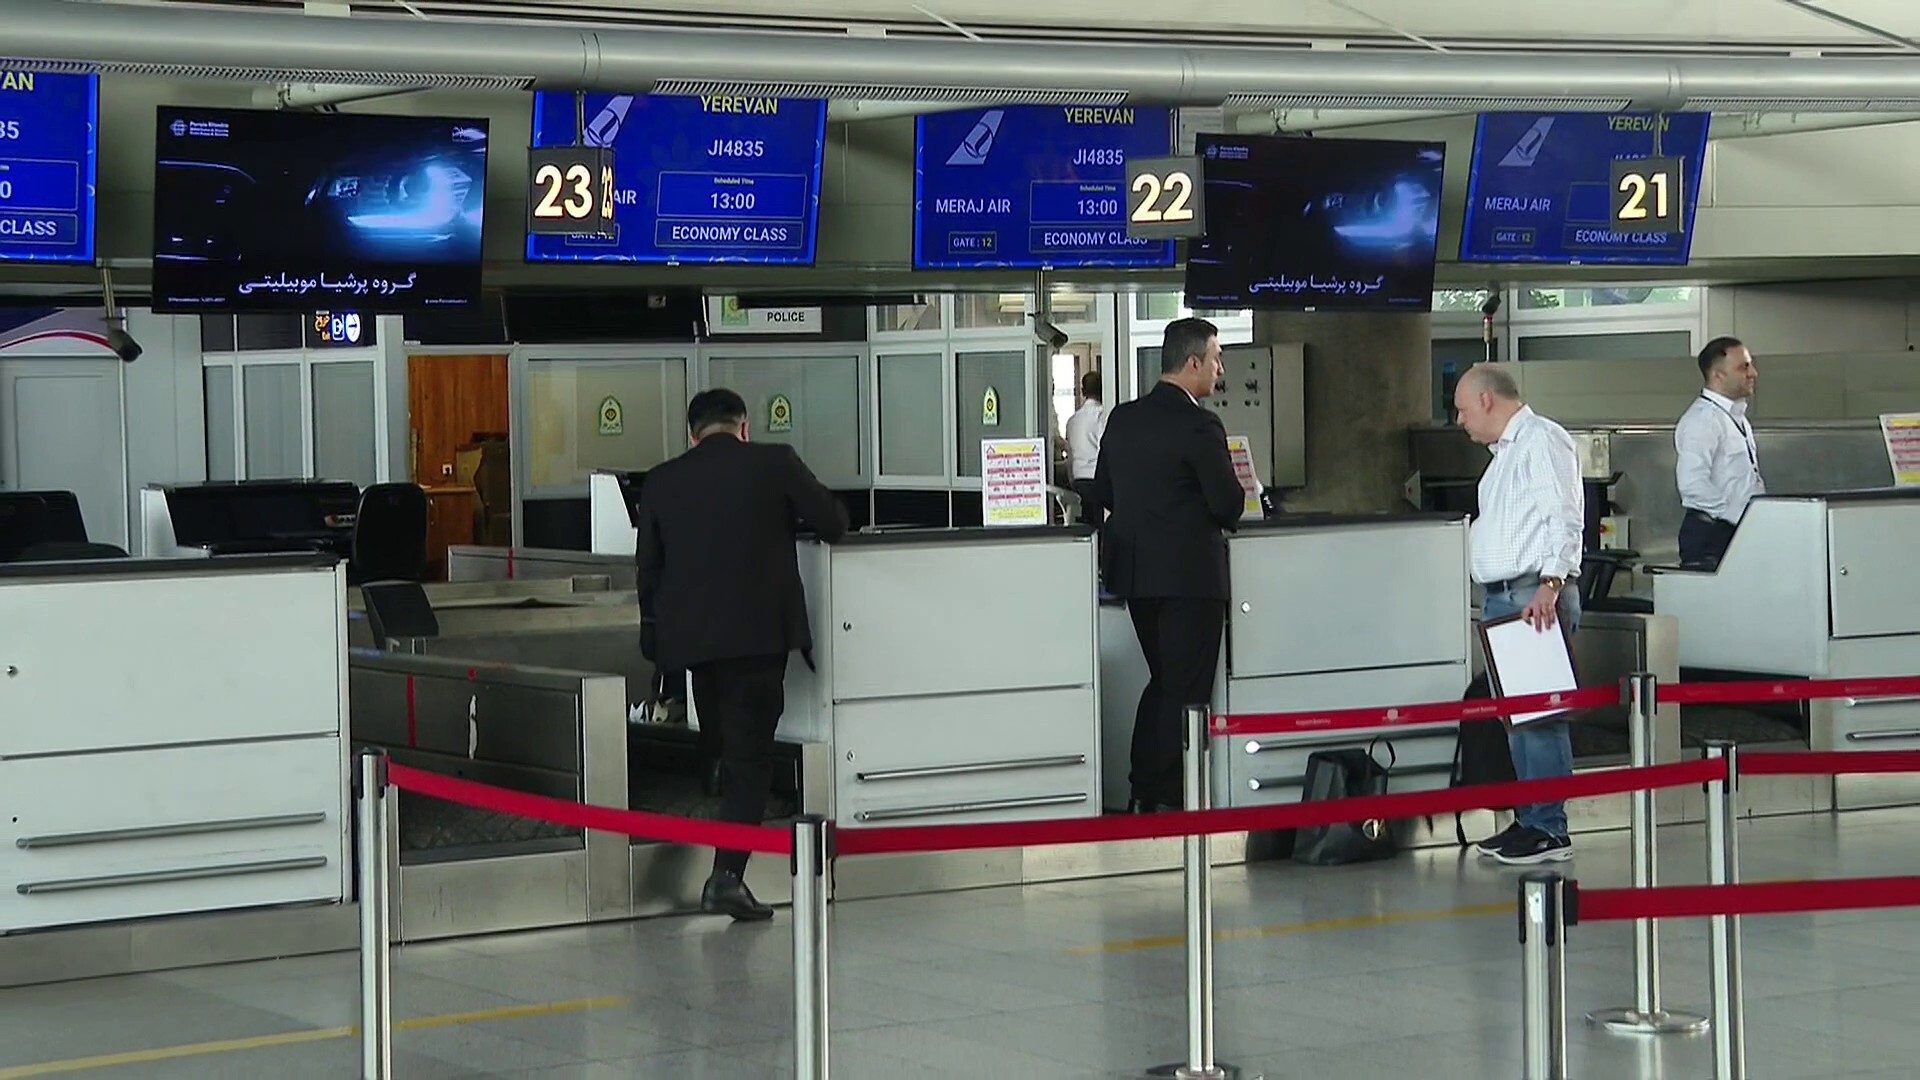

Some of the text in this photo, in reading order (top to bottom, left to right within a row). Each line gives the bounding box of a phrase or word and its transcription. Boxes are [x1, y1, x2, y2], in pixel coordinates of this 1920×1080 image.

[0, 71, 34, 91] AN
[701, 94, 778, 114] YEREVAN
[1065, 108, 1134, 124] YEREVAN
[707, 139, 764, 157] JI4835
[1073, 149, 1124, 166] JI4835
[533, 164, 593, 219] 23
[601, 164, 613, 219] 23
[614, 189, 637, 205] AIR
[1131, 172, 1193, 222] 22
[1618, 172, 1668, 219] 21
[710, 193, 755, 209] 13:00
[935, 199, 1011, 213] MERAJ AIR
[1077, 200, 1118, 215] 13:00
[1485, 197, 1551, 211] MERAJ AIR
[0, 219, 57, 236] CLASS
[672, 226, 788, 241] ECONOMY CLASS
[953, 237, 976, 248] GATE
[982, 237, 992, 248] 12
[1044, 231, 1105, 246] ECONOMY
[1496, 232, 1516, 242] GATE
[1575, 230, 1668, 243] ECONOMY CLASS
[238, 272, 417, 294] گروه پرشیا موبیلیتی
[1249, 274, 1384, 294] گروه پرشیا موبیلیتی
[767, 312, 804, 322] POLICE
